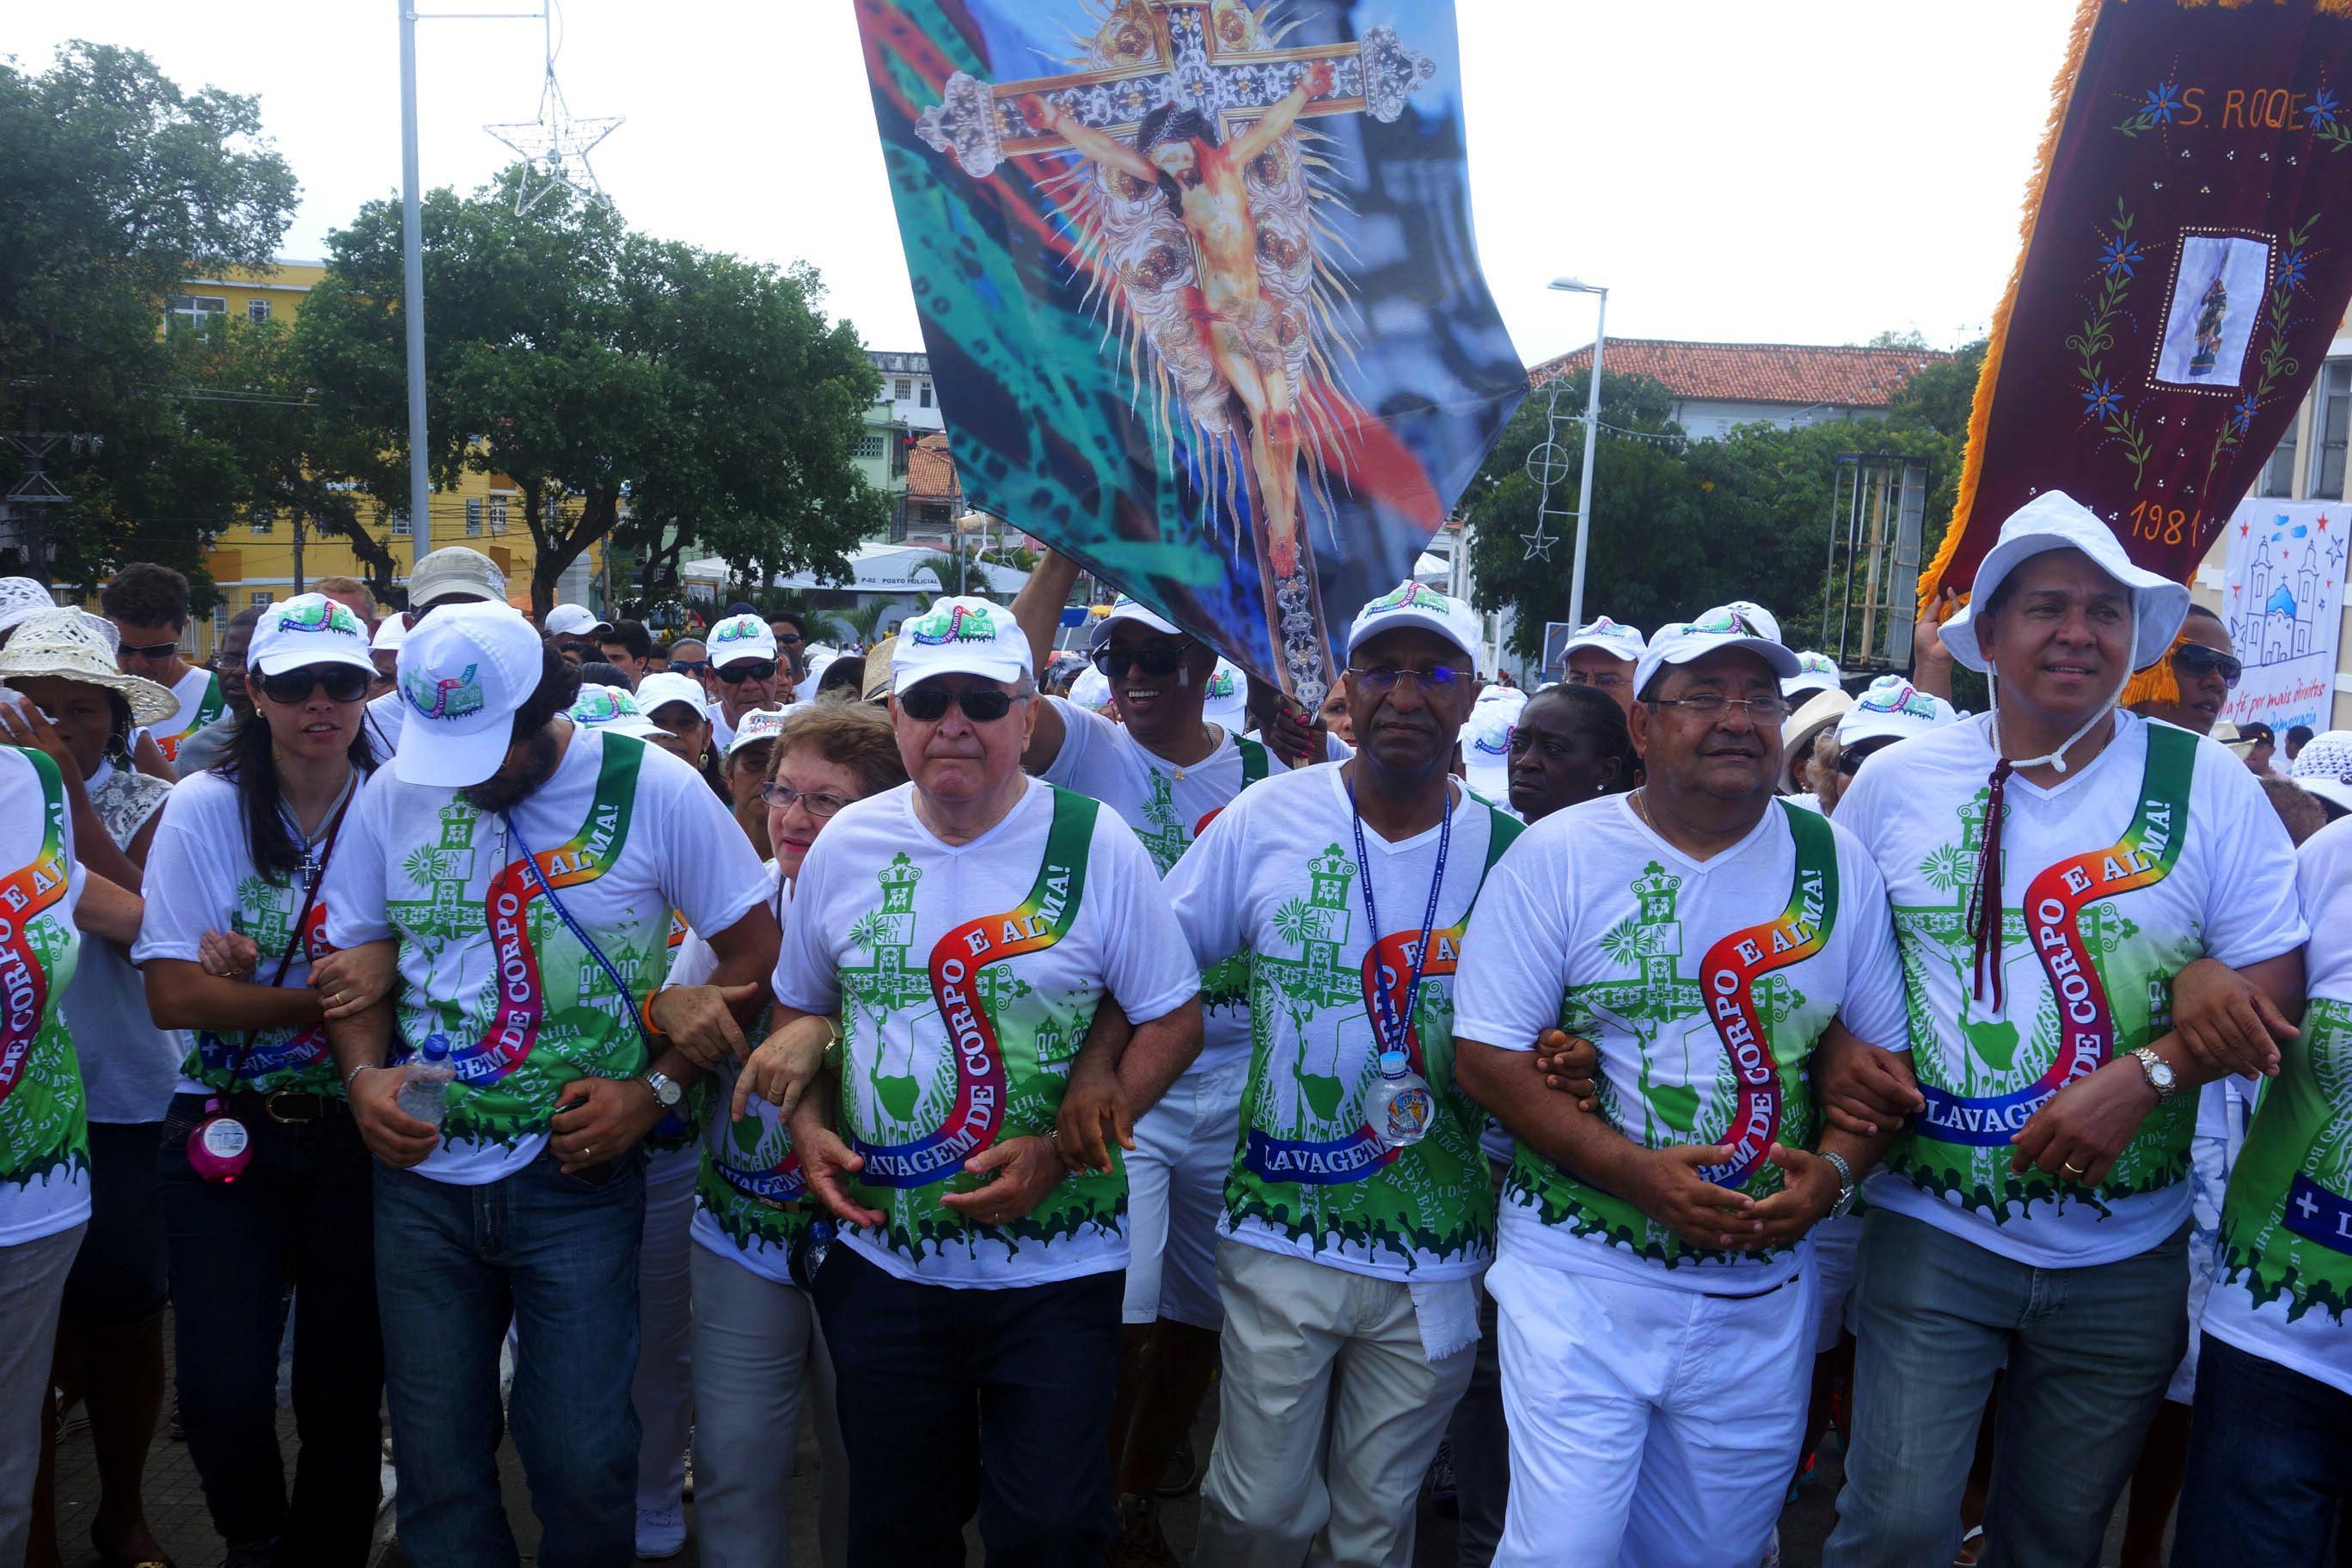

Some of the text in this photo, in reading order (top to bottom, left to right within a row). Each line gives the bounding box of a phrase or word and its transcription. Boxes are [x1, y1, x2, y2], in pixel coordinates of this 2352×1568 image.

[2178, 88, 2209, 128] S.
[2130, 500, 2201, 548] 1981
[2247, 694, 2266, 723] por
[2267, 686, 2291, 709] mais
[2293, 677, 2326, 703] direitos
[2103, 799, 2171, 882] ALMA!
[1360, 862, 1369, 888] Lembrança
[2061, 866, 2092, 896] E
[497, 804, 619, 1051] DE CORPO E ALMA!
[1001, 865, 1072, 944] ALMA!
[963, 928, 990, 956] E
[2038, 898, 2098, 1024] CORPO
[942, 959, 990, 1076] CORPO
[1714, 869, 1823, 1141] DE CORPO E ALMA!
[2069, 1033, 2102, 1081] DE
[965, 1085, 995, 1130] DE
